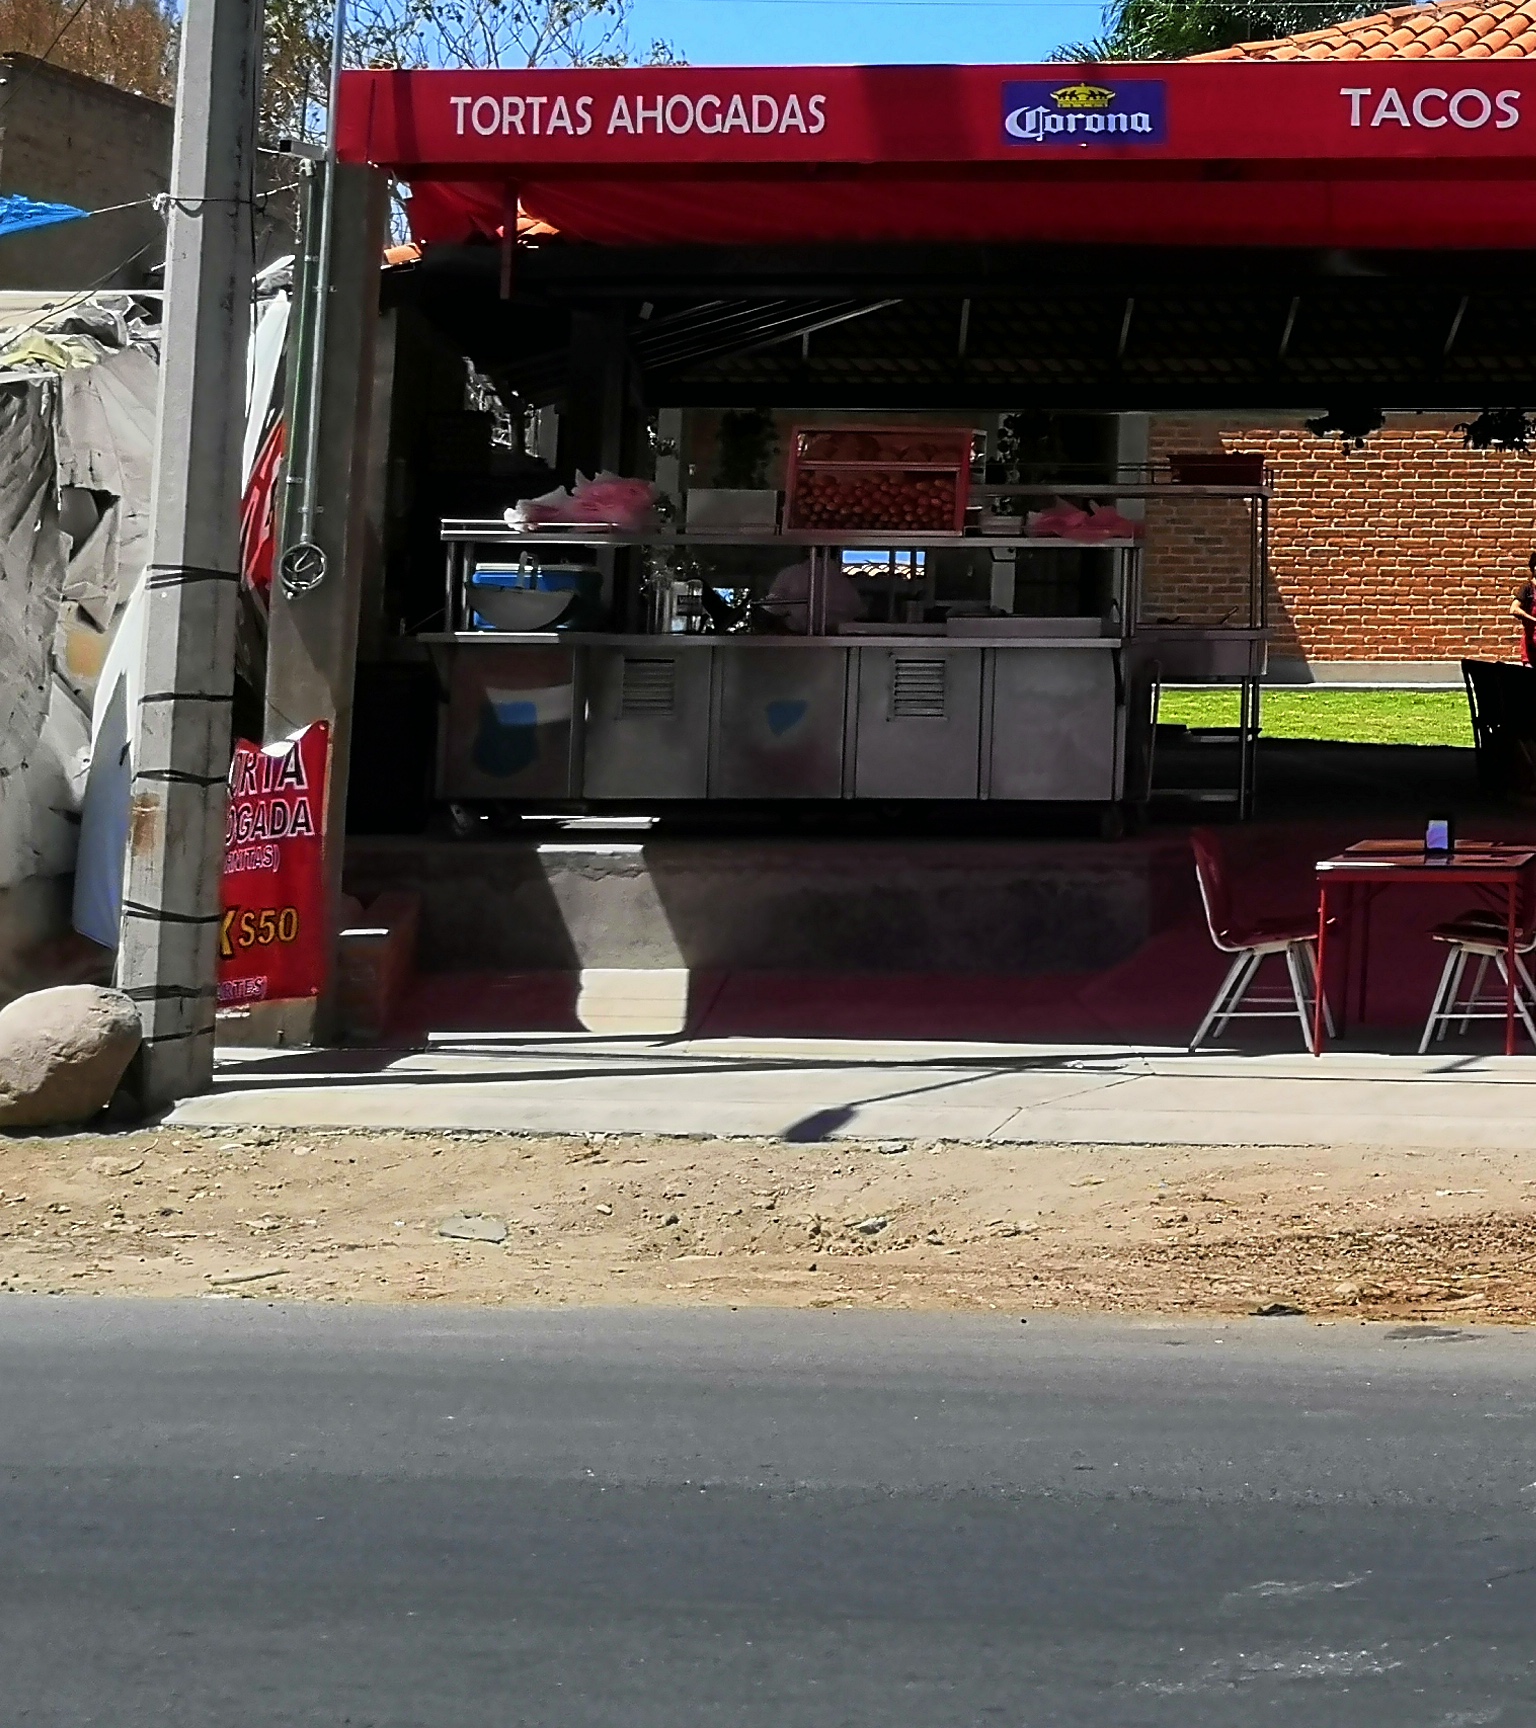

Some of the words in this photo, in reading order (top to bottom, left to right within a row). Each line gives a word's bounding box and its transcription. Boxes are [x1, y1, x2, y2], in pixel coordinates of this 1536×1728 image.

[450, 96, 594, 136] TORTAS
[606, 93, 826, 135] AHOGADAS
[1004, 107, 1153, 142] Corona
[1340, 87, 1521, 129] TACOS
